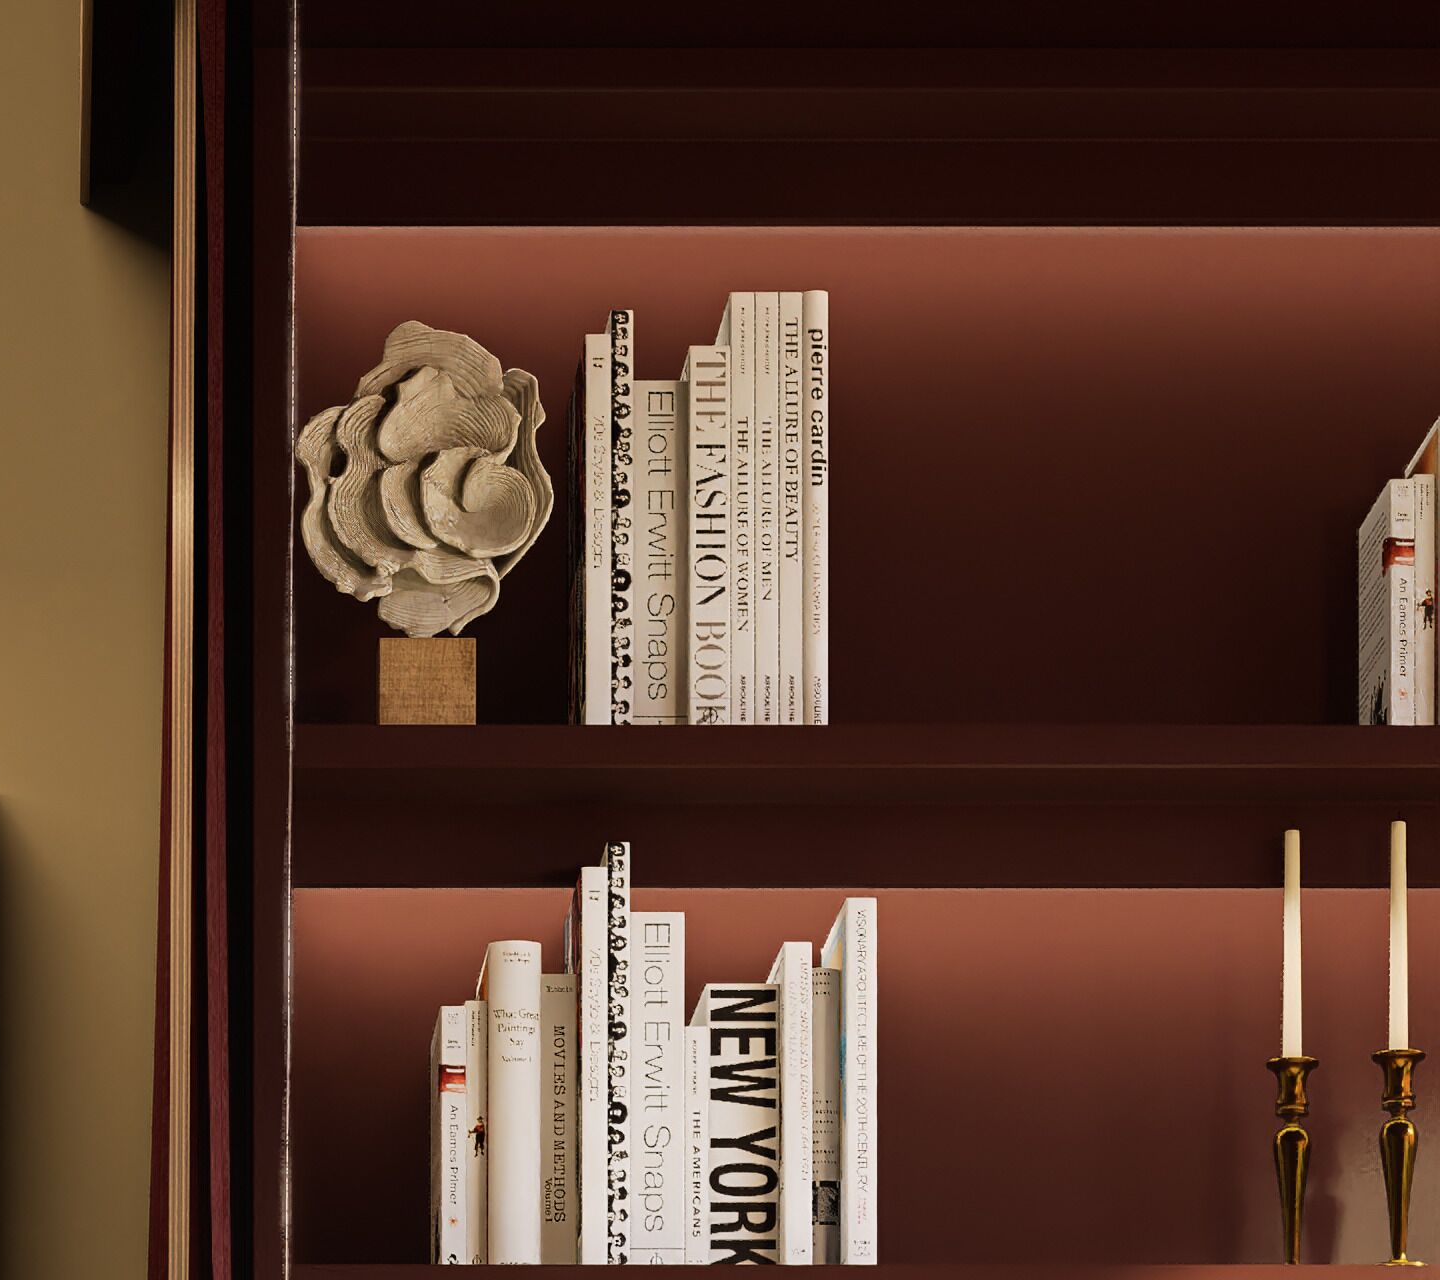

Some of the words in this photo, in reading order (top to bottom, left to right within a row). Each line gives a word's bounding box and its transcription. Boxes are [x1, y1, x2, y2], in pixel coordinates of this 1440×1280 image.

[785, 316, 799, 360] THE
[809, 328, 827, 401] pierre
[695, 351, 727, 432] THE
[785, 364, 799, 444] ALLURE
[647, 390, 675, 477] Elliott
[737, 416, 749, 455] THE
[762, 415, 773, 455] THE
[785, 447, 799, 476] OF
[811, 409, 827, 487] cardin
[694, 443, 728, 607] FASHION
[737, 458, 749, 529] ALLURE
[762, 459, 773, 529] ALLURE
[785, 479, 799, 563] BEAUTY
[647, 490, 675, 581] Erwitt
[737, 533, 749, 557] OF
[762, 533, 773, 558] OF
[737, 561, 749, 633] WOMEN
[762, 560, 773, 602] MEN
[1398, 576, 1408, 594] An
[641, 592, 675, 701] Snaps
[1398, 597, 1408, 638] Eames
[695, 621, 727, 725] BOOK
[1398, 638, 1408, 678] Primer
[644, 922, 671, 1008] Elliott
[553, 1025, 567, 1096] MOVIES
[644, 1021, 671, 1113] Erwitt
[710, 989, 778, 1109] NEW
[449, 1104, 459, 1121] An
[449, 1123, 459, 1163] Eames
[553, 1100, 567, 1136] AND
[693, 1110, 702, 1139] THE
[449, 1165, 459, 1205] Primer
[544, 1177, 554, 1216] Volume
[553, 1140, 567, 1223] METHODS
[638, 1124, 672, 1233] Snaps
[693, 1145, 702, 1239] AMERICANS
[710, 1125, 778, 1265] YORK
